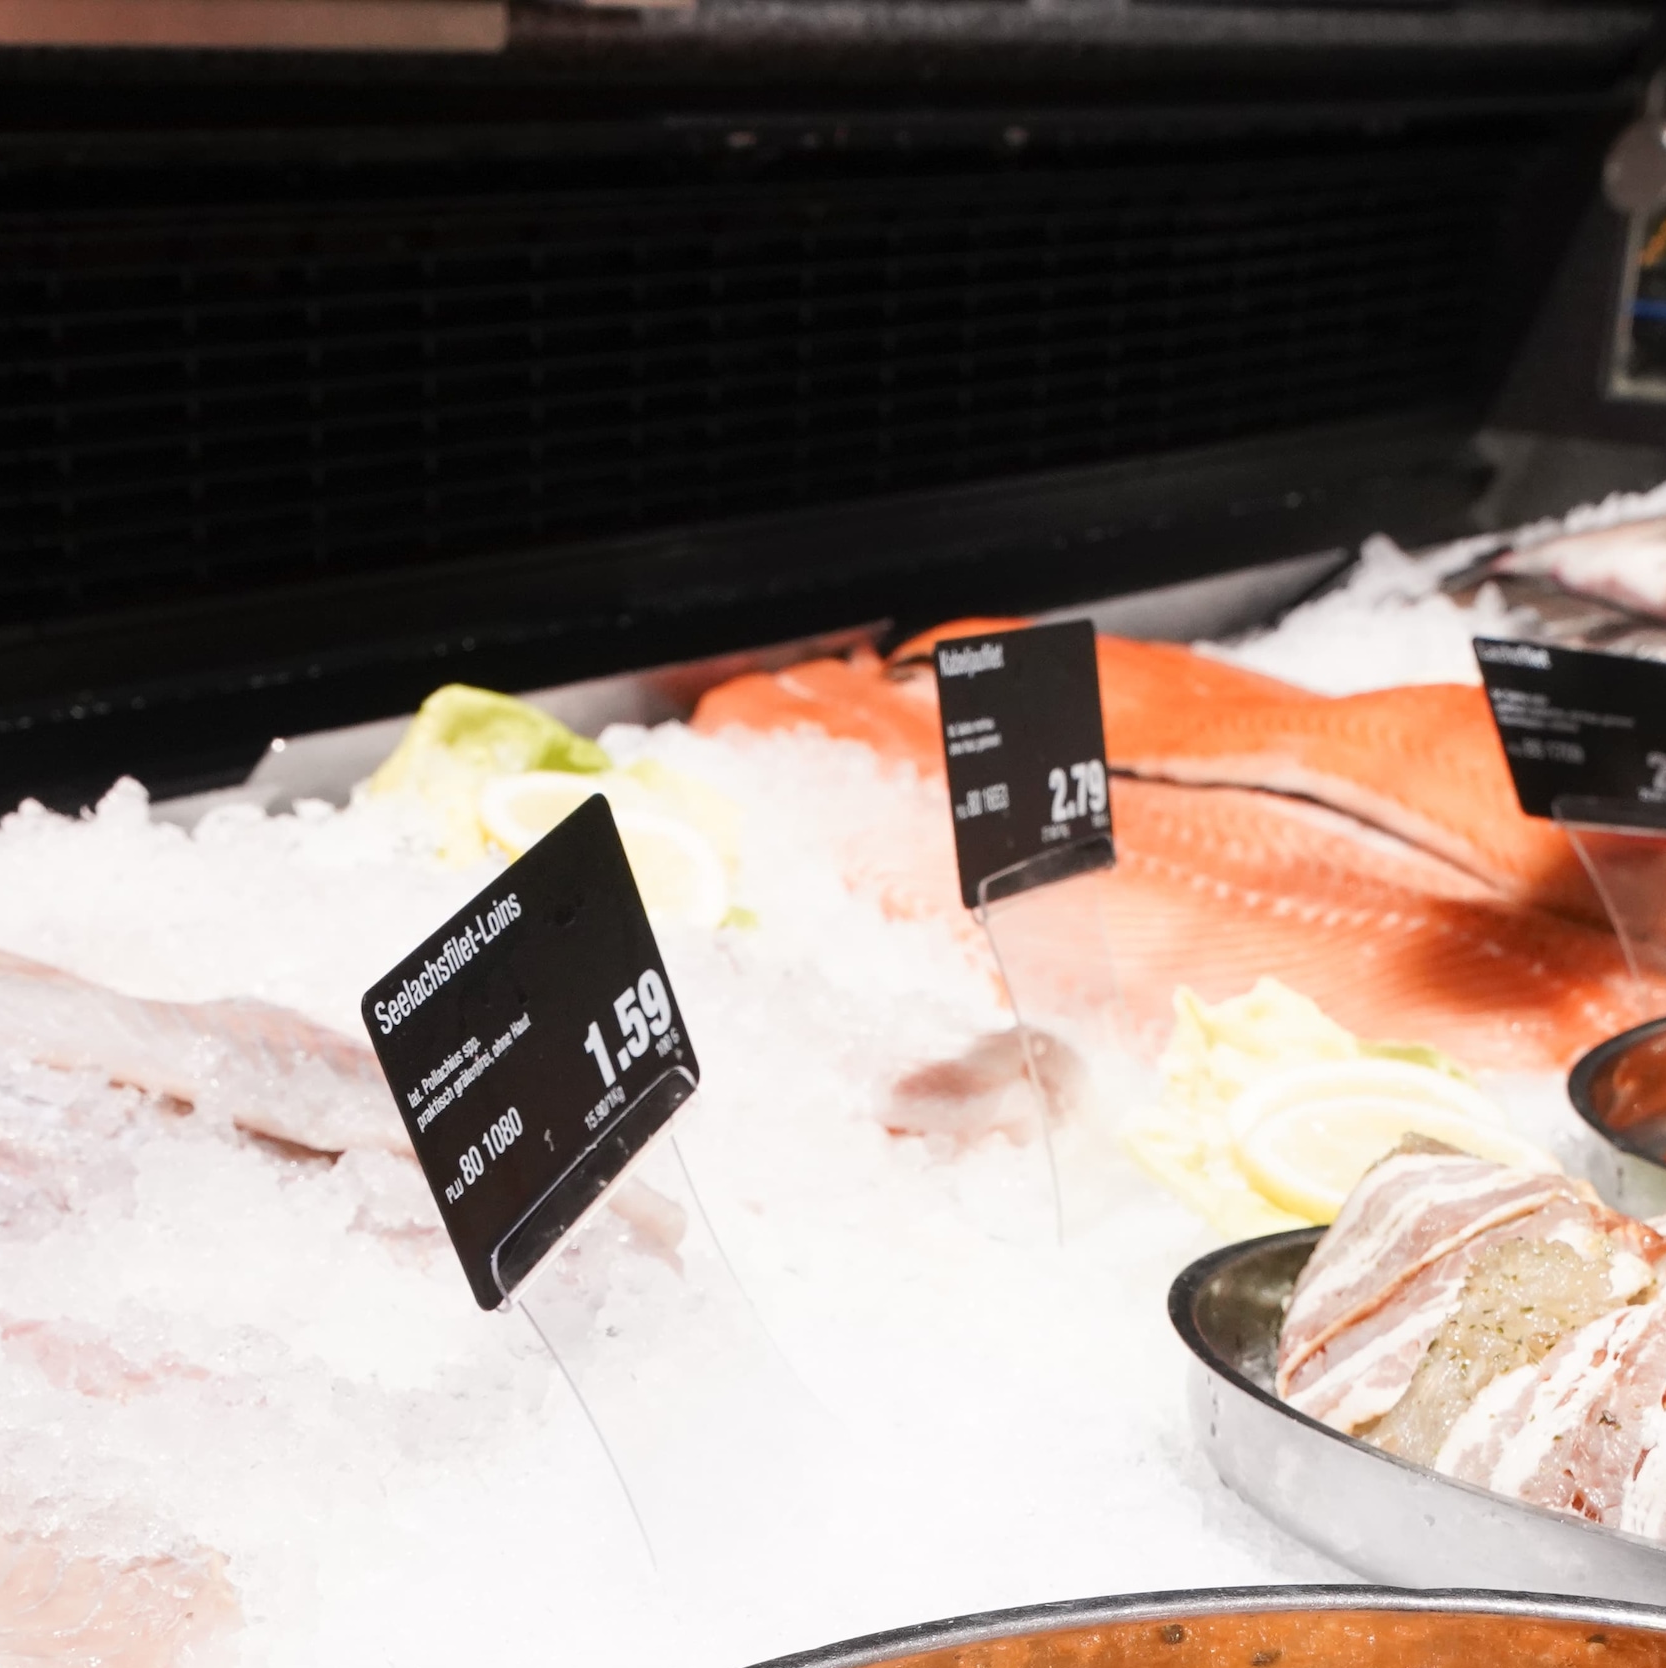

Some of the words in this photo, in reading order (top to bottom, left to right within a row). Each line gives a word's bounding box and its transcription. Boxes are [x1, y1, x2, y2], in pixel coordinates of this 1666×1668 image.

[1048, 759, 1107, 822] 2.79
[374, 893, 522, 1035] Seelachsfilet-Loins
[407, 1087, 424, 1109] lat.
[421, 1051, 464, 1095] Pollachius
[462, 1036, 481, 1058] spp.
[417, 1086, 455, 1133] praktisch
[492, 1031, 513, 1057] ohne
[509, 1012, 531, 1039] Haut
[584, 969, 672, 1088] 1.59
[445, 1177, 464, 1204] PLU
[458, 1146, 484, 1185] 80
[482, 1106, 523, 1161] 1080
